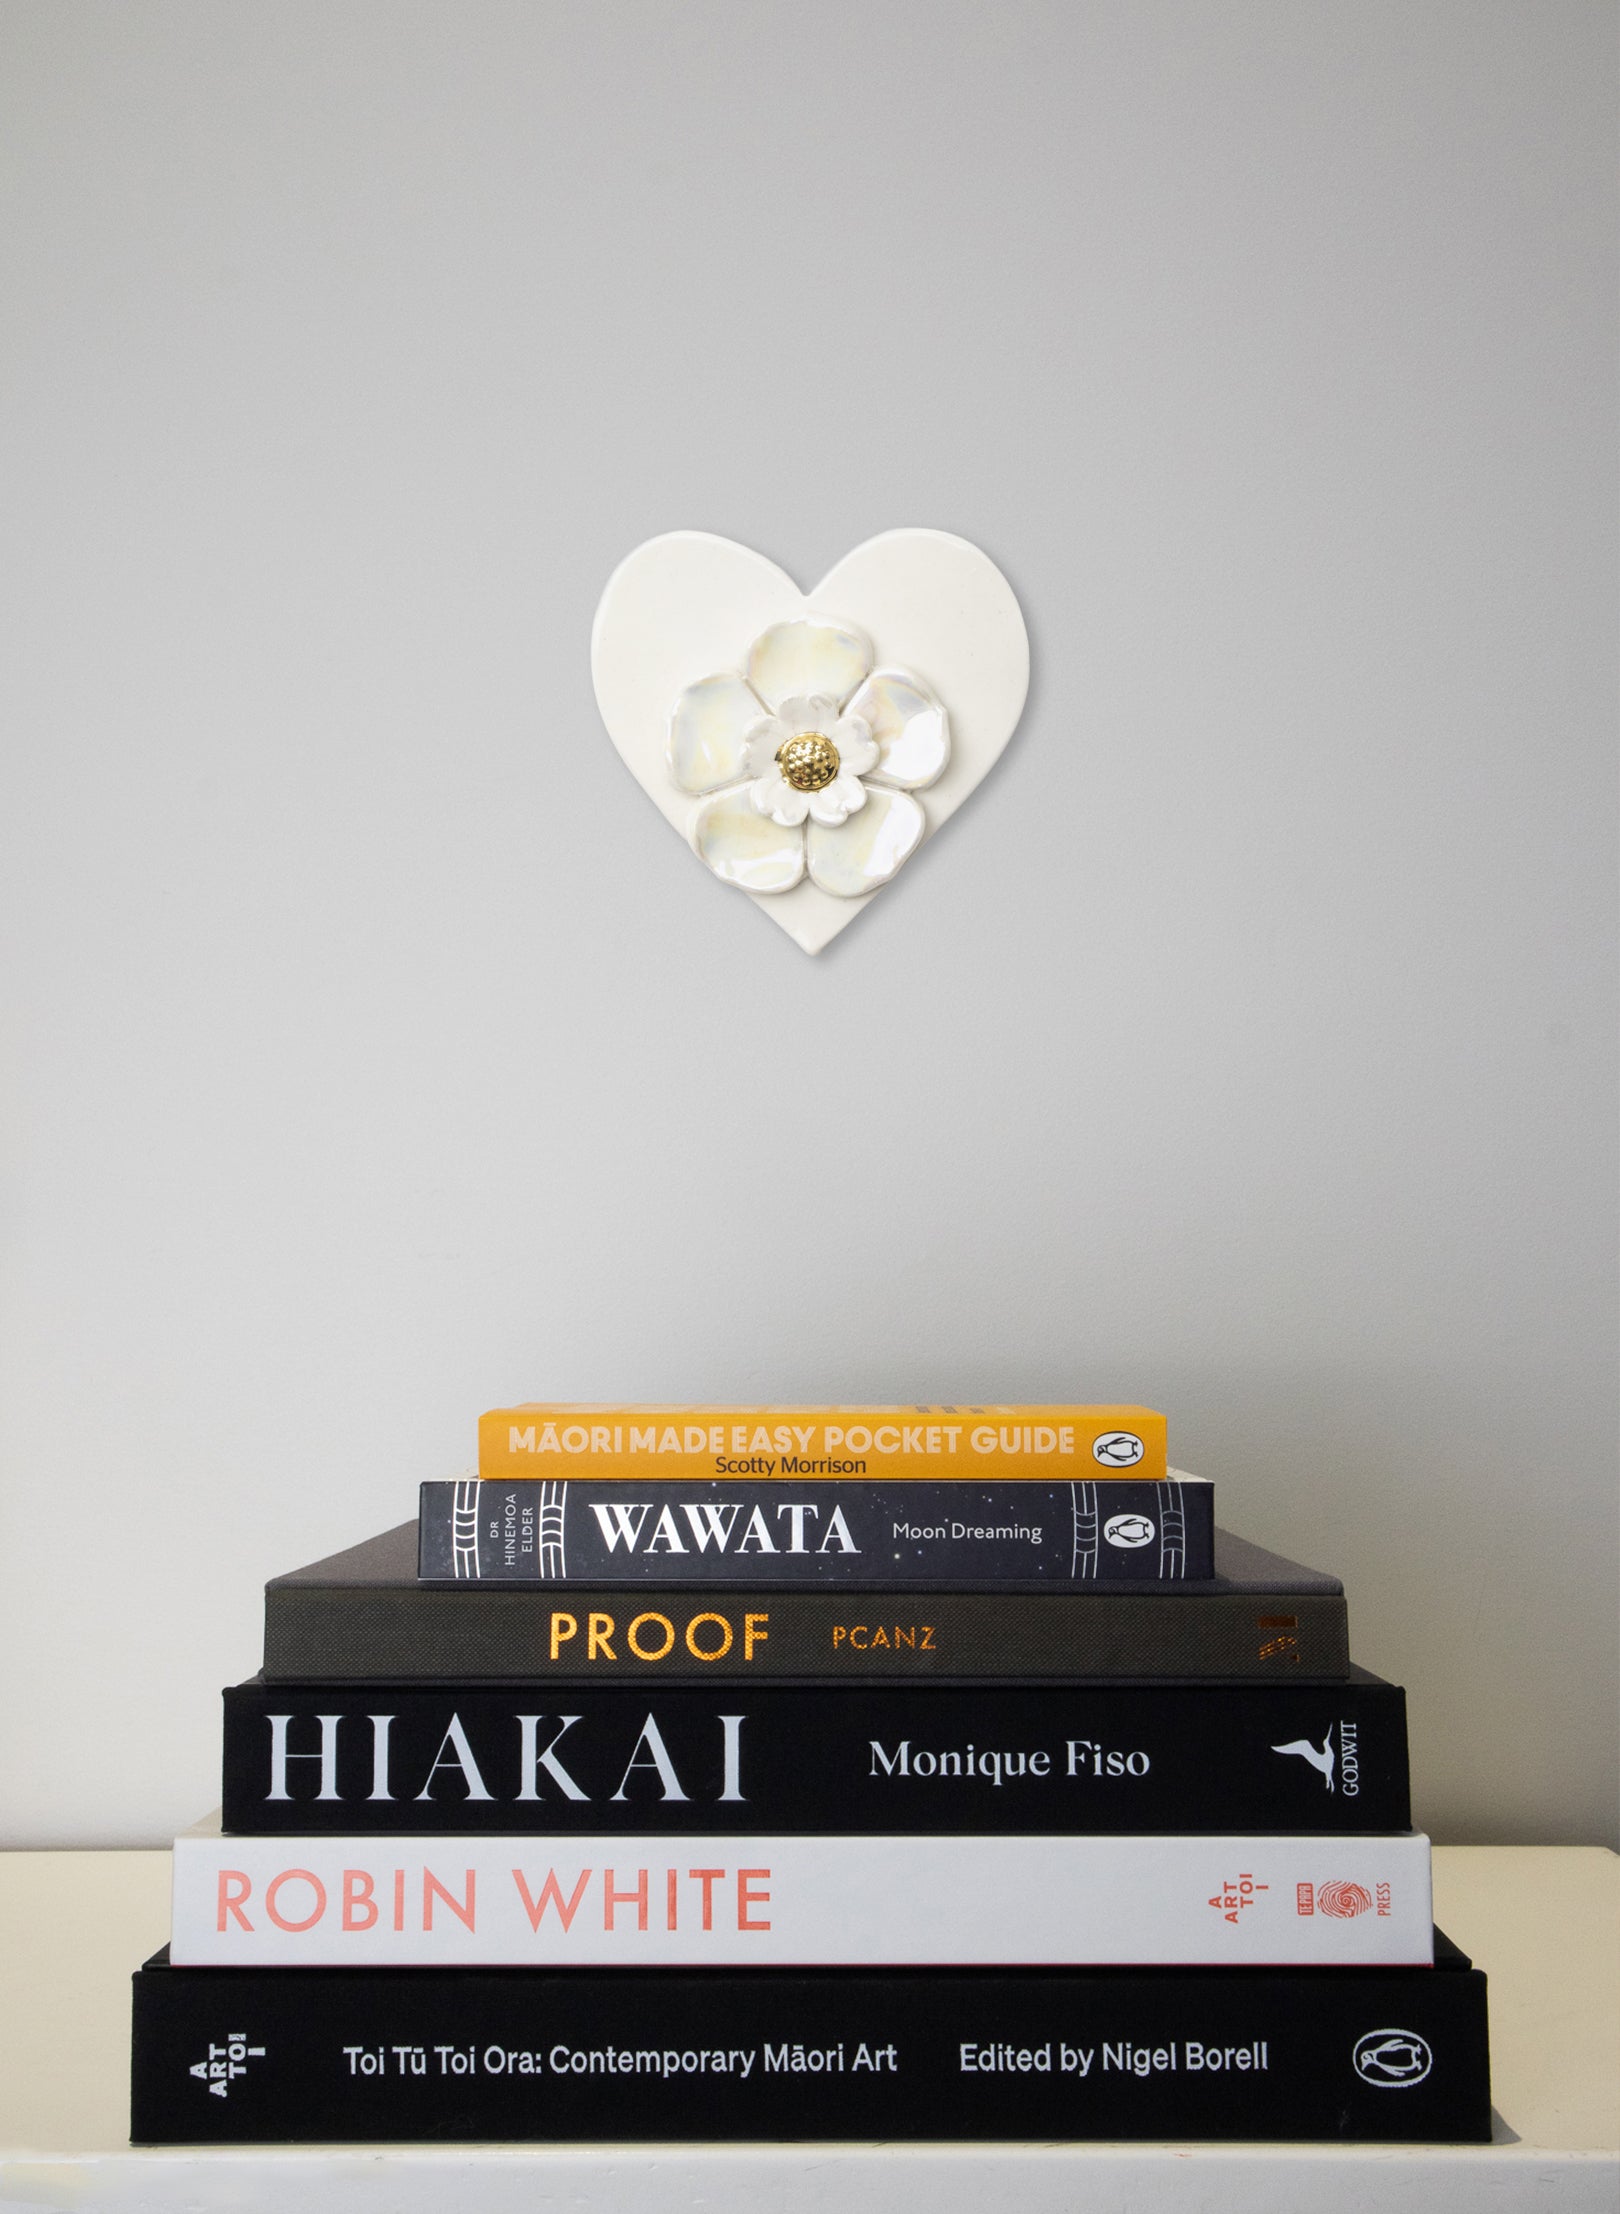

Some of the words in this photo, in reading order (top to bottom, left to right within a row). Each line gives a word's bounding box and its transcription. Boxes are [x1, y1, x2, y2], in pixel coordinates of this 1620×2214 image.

[508, 1422, 622, 1454] MĀORI
[630, 1426, 724, 1453] MADE
[731, 1425, 816, 1454] EASY
[824, 1425, 962, 1454] POCKET
[970, 1425, 1074, 1454] GUIDE
[715, 1456, 776, 1476] Scotty
[781, 1456, 866, 1474] Morrison
[489, 1521, 499, 1538] DR
[504, 1493, 516, 1565] HINEMOA
[521, 1507, 533, 1552] ELDER
[588, 1504, 861, 1553] WAWATA
[893, 1522, 946, 1539] Moon
[951, 1522, 1043, 1545] Dreaming
[550, 1612, 768, 1661] PROOF
[832, 1626, 937, 1650] PCANZ
[265, 1711, 750, 1801] HIAKAI
[868, 1738, 1050, 1786] Monique
[1065, 1738, 1151, 1777] Fiso
[1340, 1720, 1359, 1797] GODWIT
[216, 1867, 476, 1934] ROBIN
[511, 1867, 773, 1934] WHITE
[1376, 1882, 1391, 1917] PRESS
[342, 2045, 385, 2076] Toi
[391, 2045, 427, 2076] Tū
[433, 2045, 476, 2075] Toi
[483, 2044, 542, 2075] Ora:
[549, 2044, 756, 2079] Contemporary
[763, 2042, 844, 2074] Māori
[851, 2042, 898, 2073] Art
[959, 2042, 1052, 2074] Edited
[1060, 2042, 1095, 2078] by
[1102, 2041, 1177, 2077] Nigel
[1185, 2041, 1268, 2072] Borell
